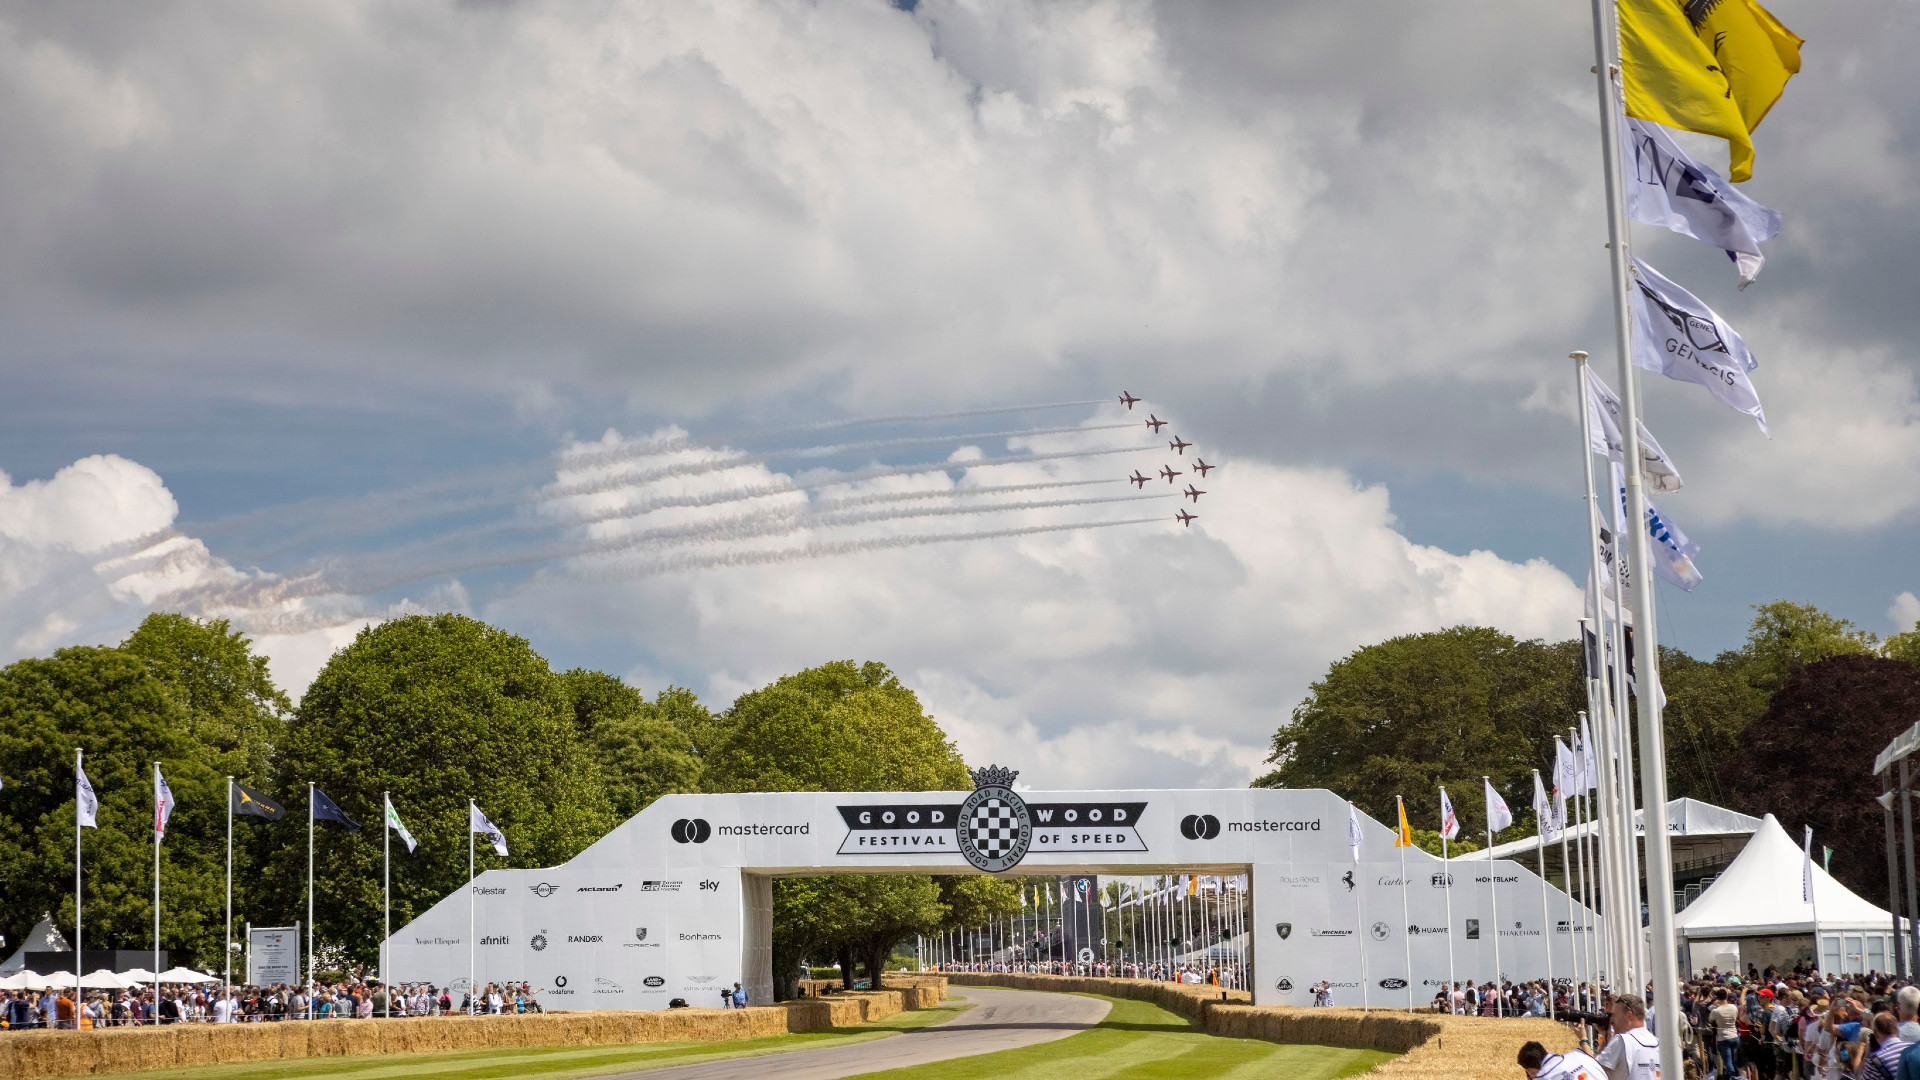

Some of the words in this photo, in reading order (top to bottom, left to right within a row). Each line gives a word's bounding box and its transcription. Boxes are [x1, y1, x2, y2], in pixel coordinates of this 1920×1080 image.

[966, 789, 991, 810] ROAD
[997, 789, 1027, 820] RACING
[858, 810, 945, 824] GOOD
[1036, 808, 1127, 823] WOOD
[718, 822, 810, 836] mastercard
[1228, 818, 1321, 832] mastercard
[859, 835, 946, 846] FESTIVAL
[1039, 834, 1061, 844] OF
[1071, 834, 1127, 844] SPEED
[960, 814, 989, 868] GOODWOOD
[1001, 824, 1029, 868] COMPANY
[472, 886, 507, 896] Polestar
[577, 885, 620, 893] McLaren
[641, 883, 661, 892] GR
[699, 878, 720, 892] sky
[568, 935, 604, 943] RANDOX
[679, 932, 722, 941] Bonhams
